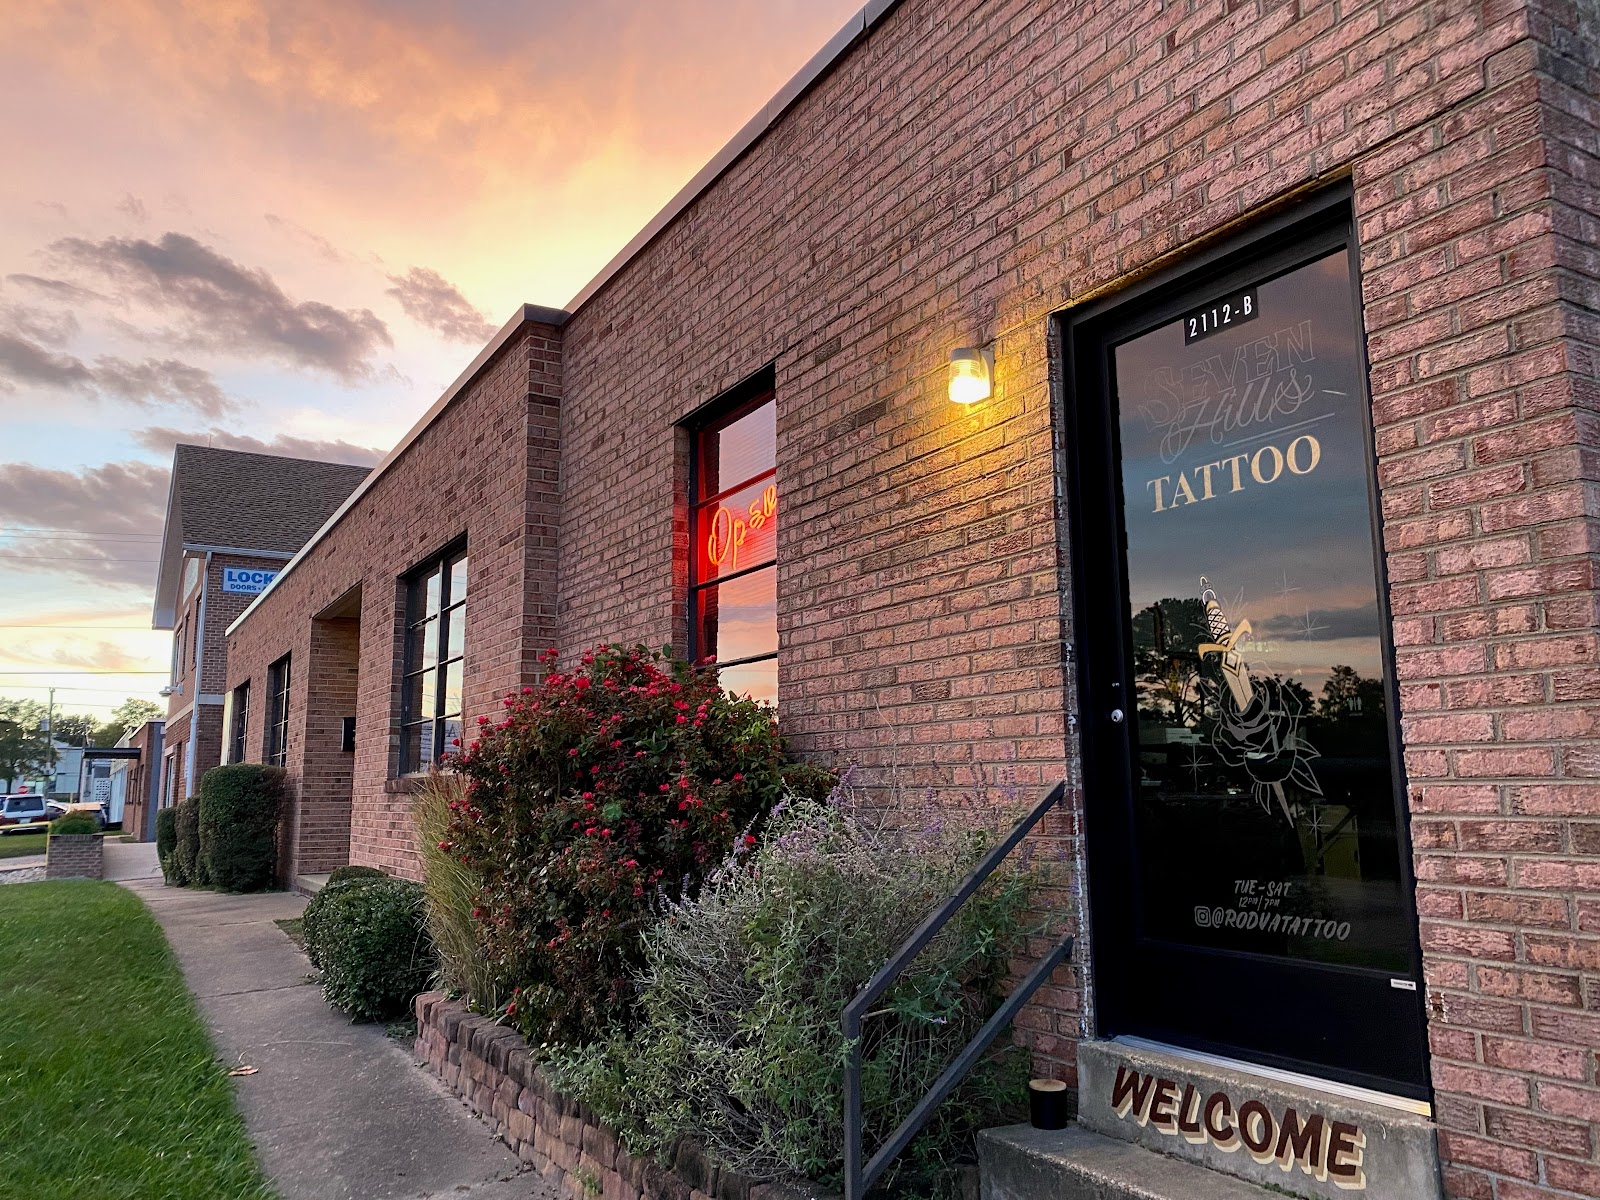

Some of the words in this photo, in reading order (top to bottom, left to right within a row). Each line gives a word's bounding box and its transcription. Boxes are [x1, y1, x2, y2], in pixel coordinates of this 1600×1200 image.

[1189, 295, 1252, 337] 2112-B
[1138, 319, 1316, 431] SEVEN
[1160, 368, 1315, 465] Hills
[1147, 435, 1321, 513] TATTOO
[1211, 906, 1351, 941] @RODVATATTOO
[1111, 1065, 1367, 1190] WELCOME
